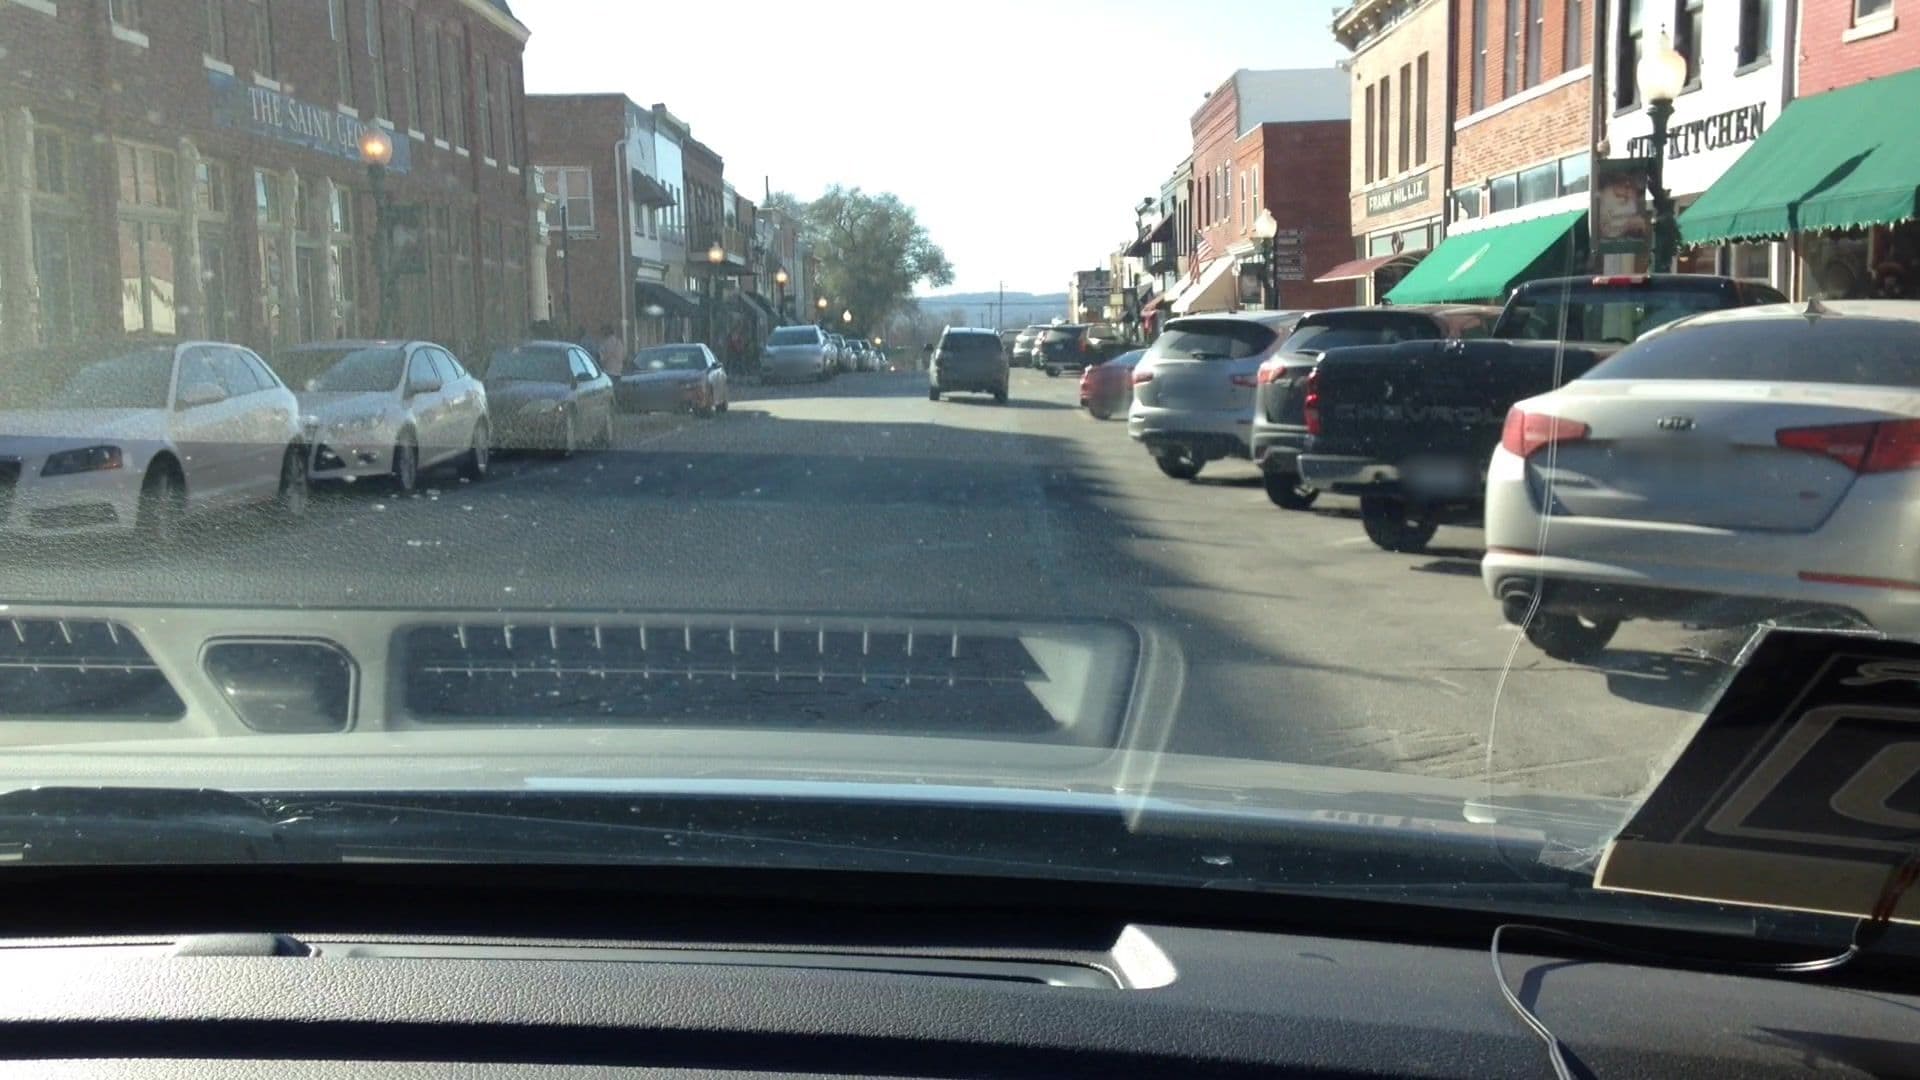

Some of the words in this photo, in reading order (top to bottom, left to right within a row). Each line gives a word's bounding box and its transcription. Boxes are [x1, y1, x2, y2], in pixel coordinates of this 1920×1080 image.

[248, 87, 282, 128] THE
[288, 98, 331, 142] SAINT
[1668, 101, 1766, 160] KITCHEN
[1334, 403, 1505, 424] CHEVROL
